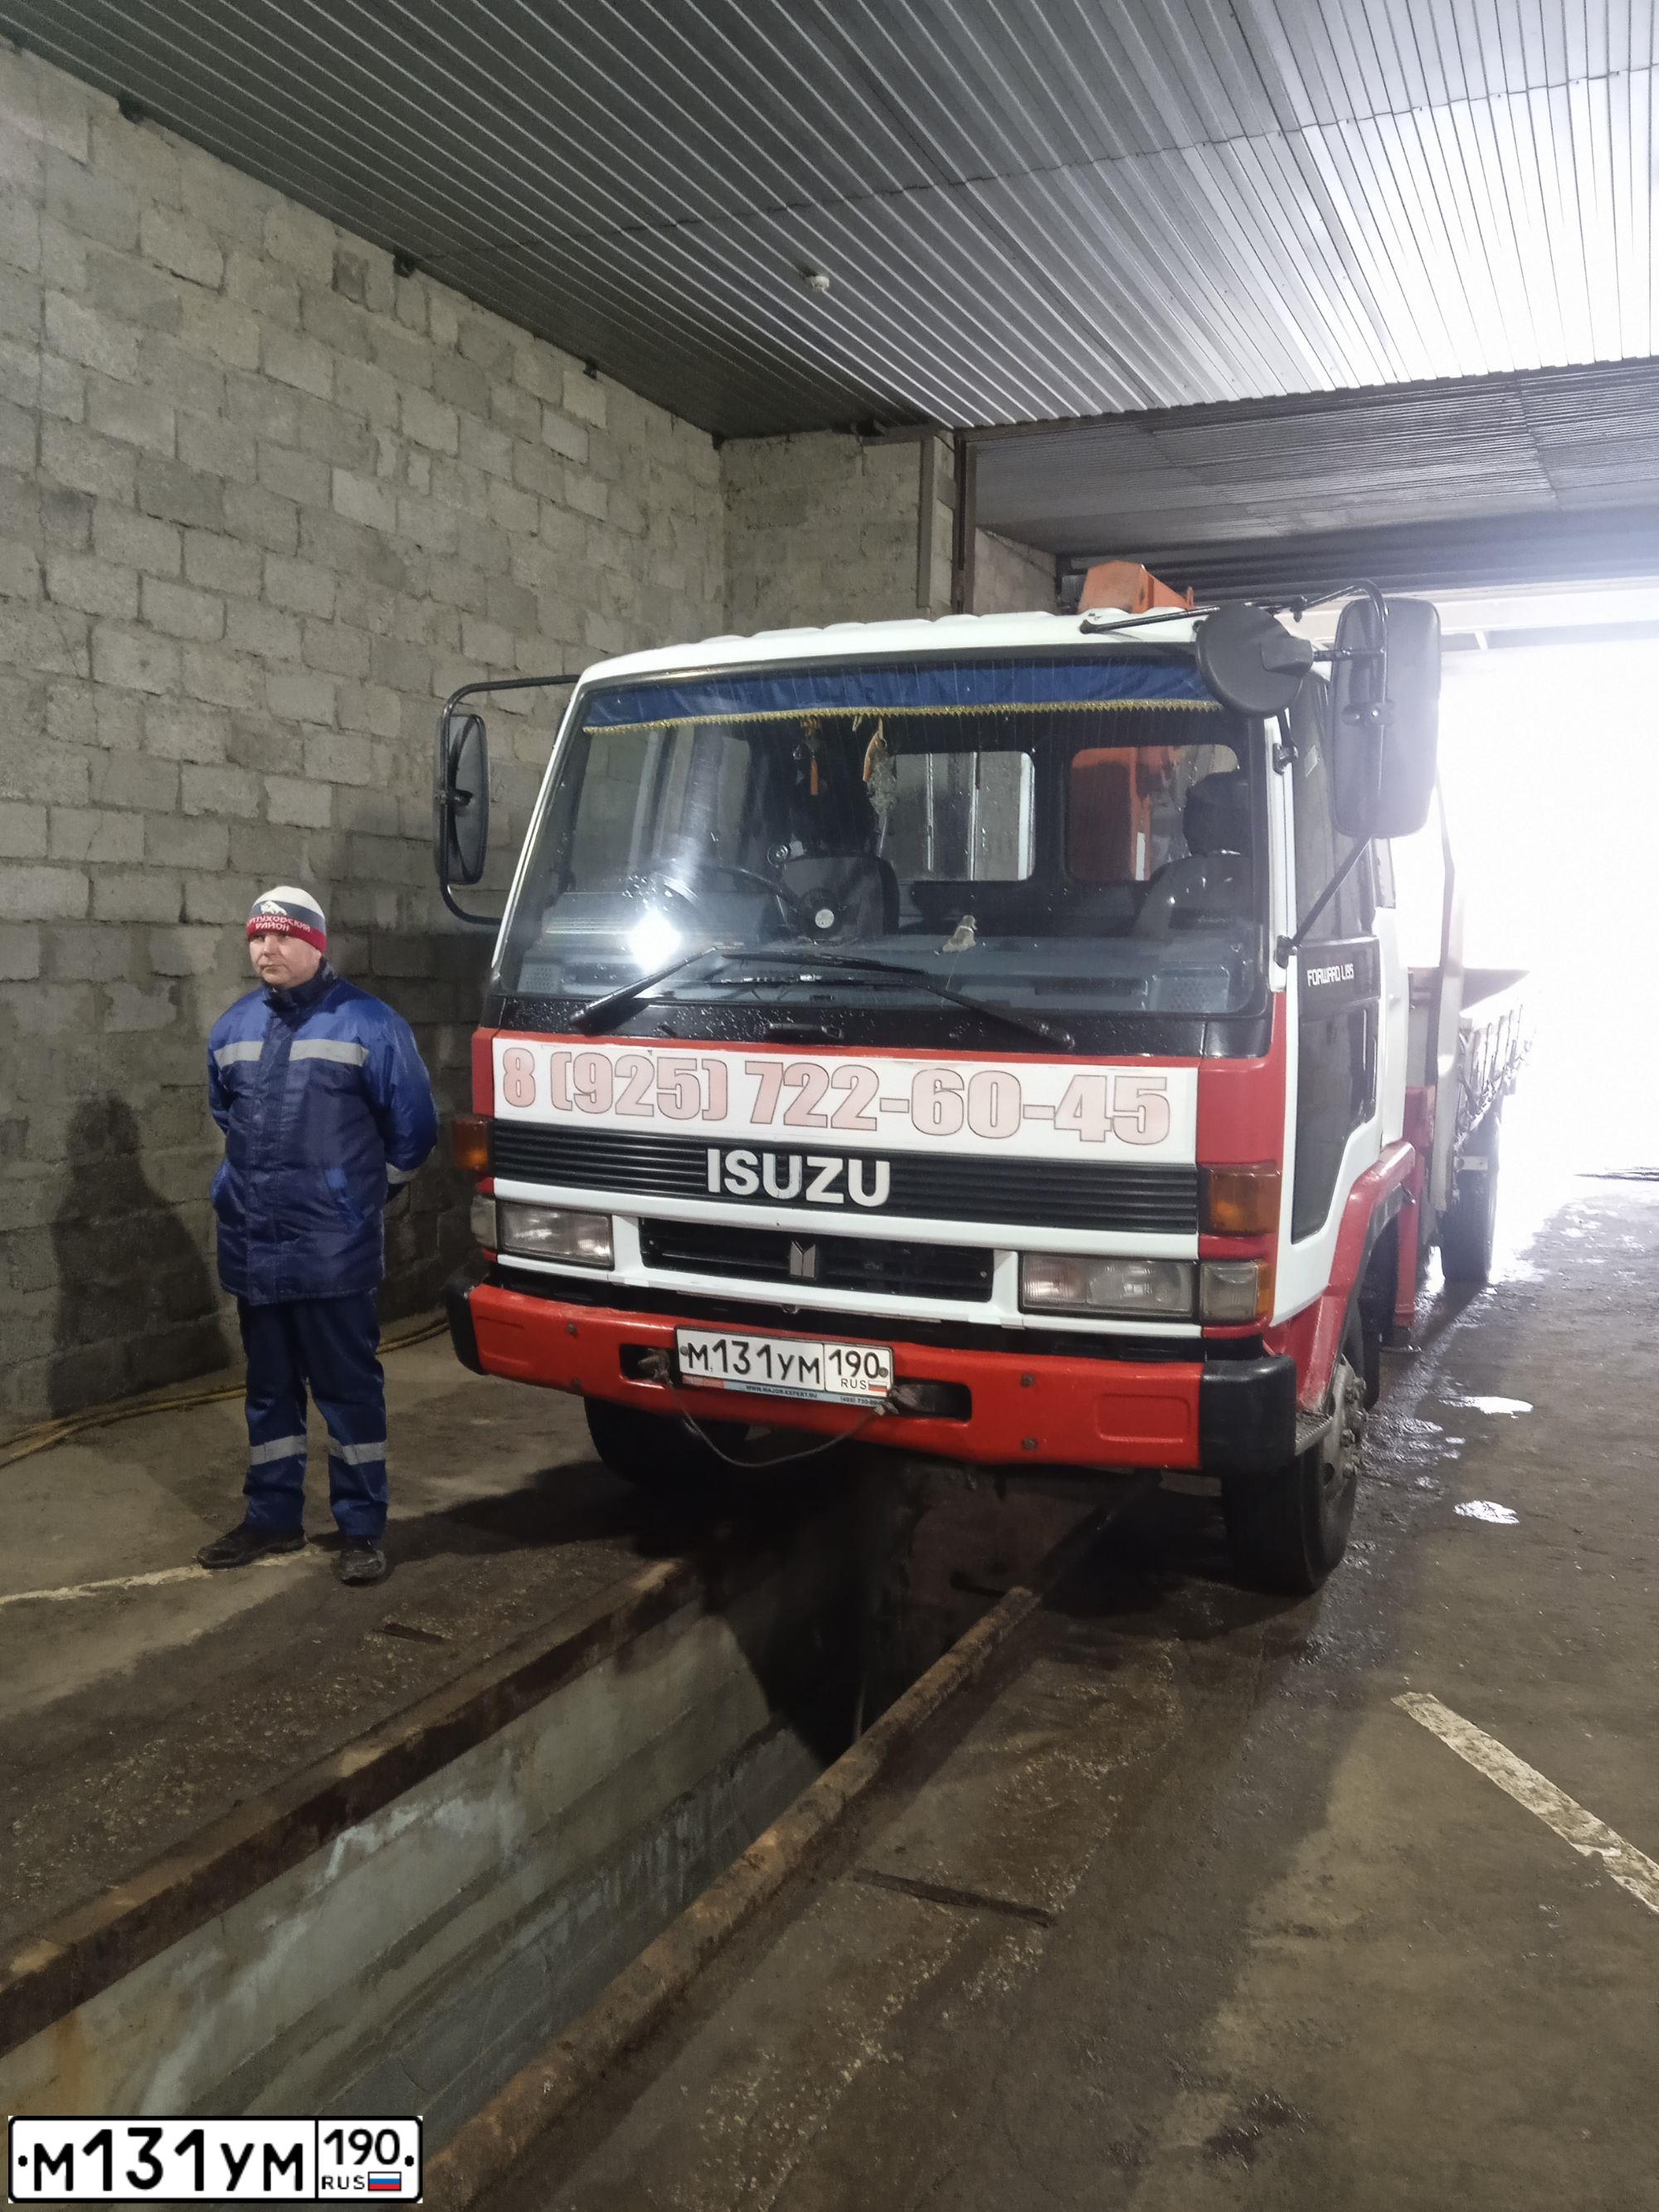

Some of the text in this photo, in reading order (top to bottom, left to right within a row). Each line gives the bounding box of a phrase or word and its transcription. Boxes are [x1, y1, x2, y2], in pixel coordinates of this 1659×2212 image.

[1307, 966, 1340, 987] FORWARD
[502, 1047, 1171, 1146] 8 (925) 722-60-45
[706, 1148, 892, 1208] ISUZU
[829, 1348, 880, 1380] 190
[840, 1378, 867, 1391] RUS
